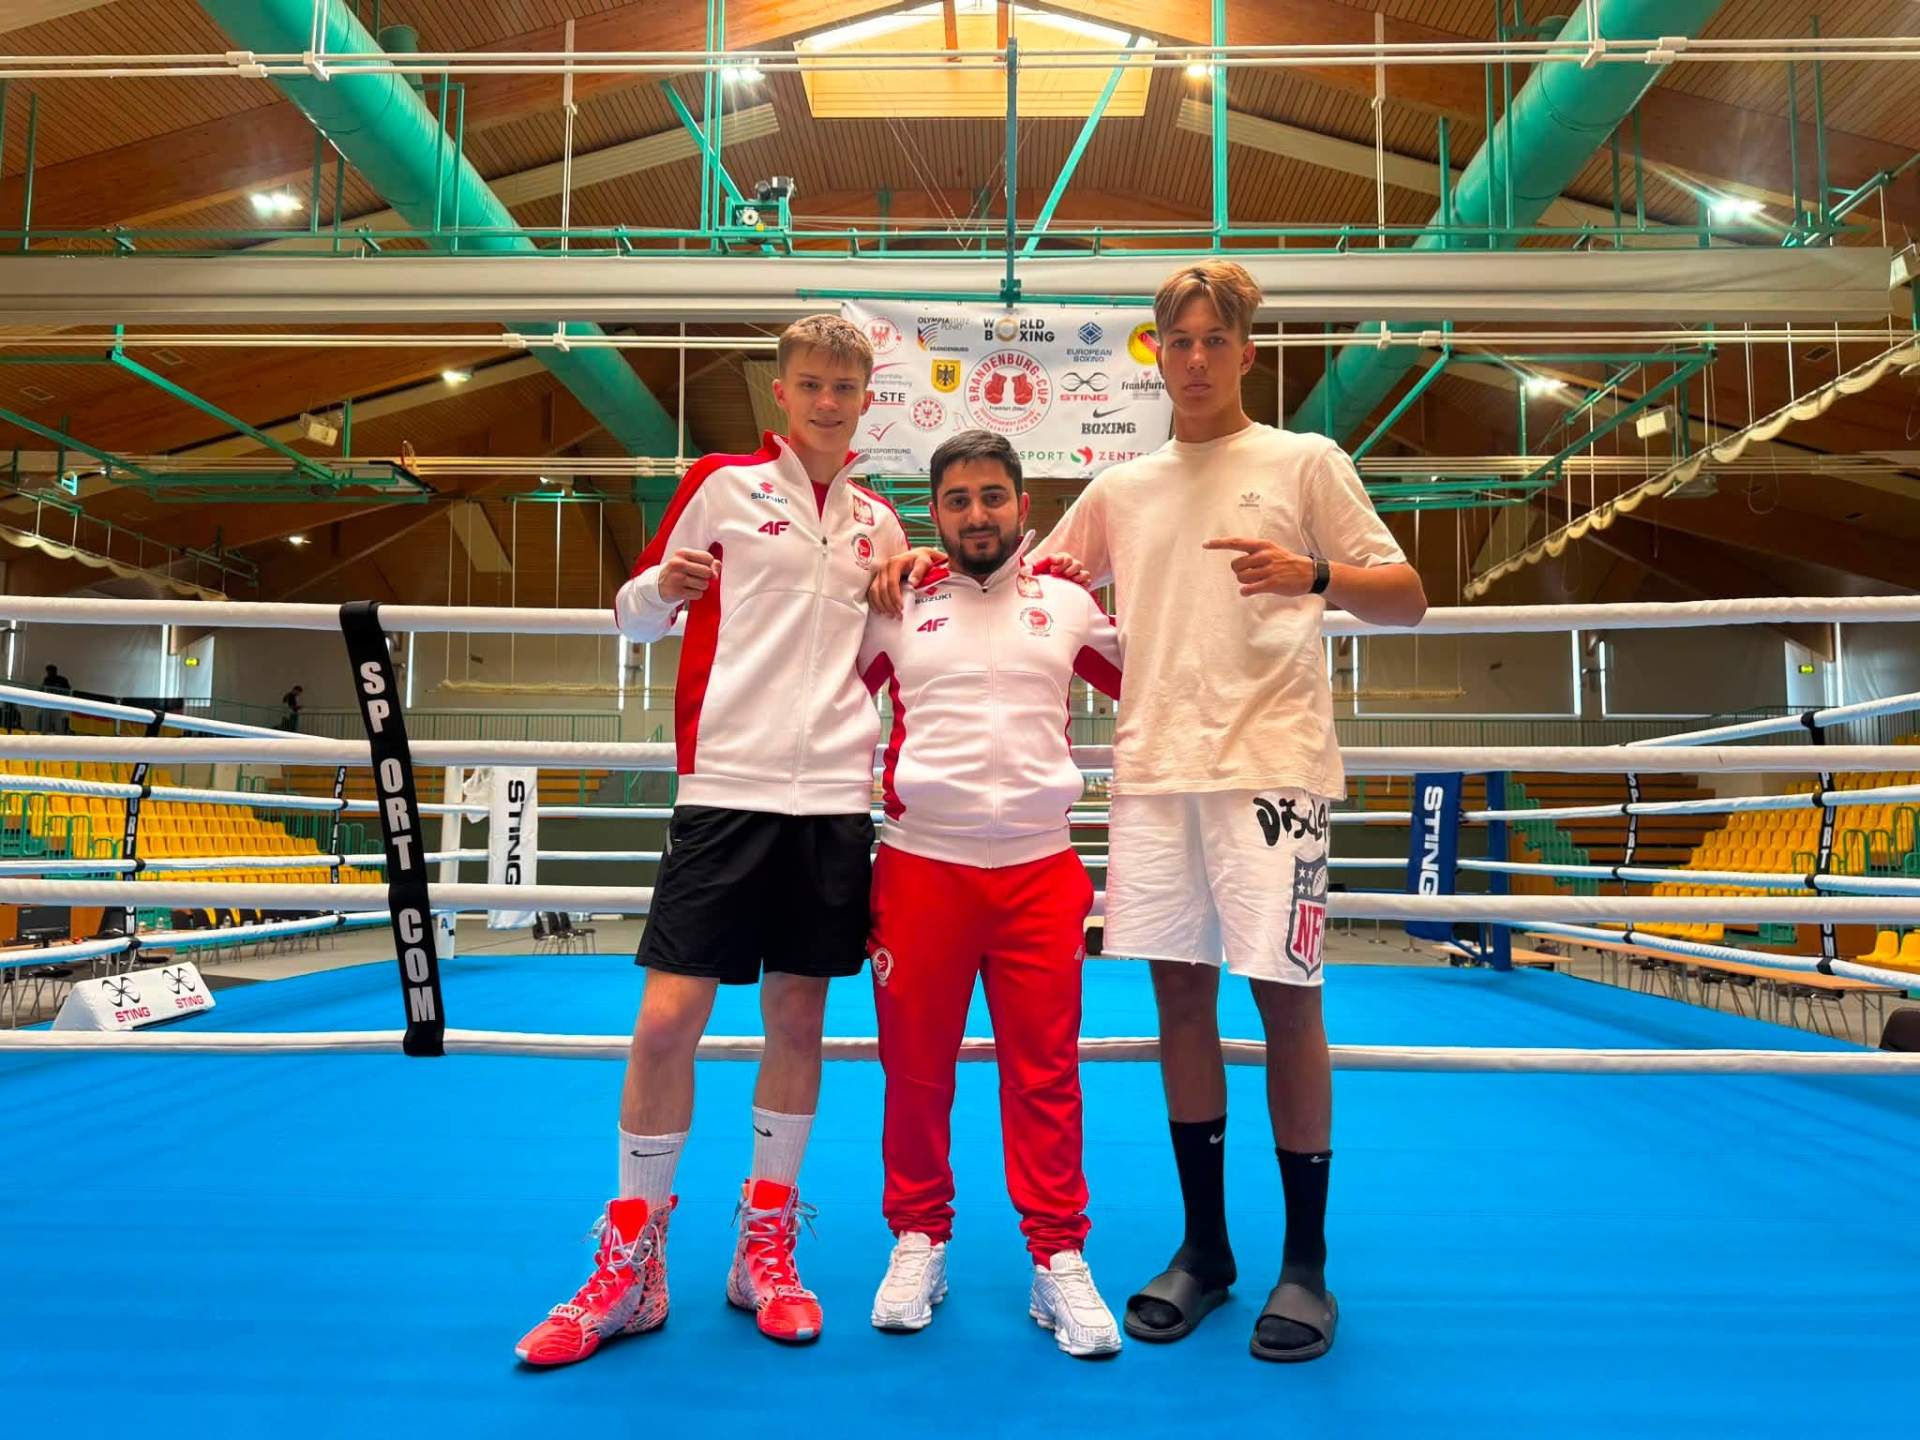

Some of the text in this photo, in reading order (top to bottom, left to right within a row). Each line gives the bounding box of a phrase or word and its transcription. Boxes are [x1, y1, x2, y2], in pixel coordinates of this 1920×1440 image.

[1019, 451, 1149, 460] SPORT ZENT
[1081, 422, 1136, 434] BOXING
[125, 764, 146, 855] PORT
[505, 779, 526, 885] STING
[1418, 785, 1444, 896] STING
[1819, 773, 1834, 868] PORT
[175, 995, 204, 1009] STING
[399, 908, 435, 1022] COM
[115, 1006, 151, 1023] STING
